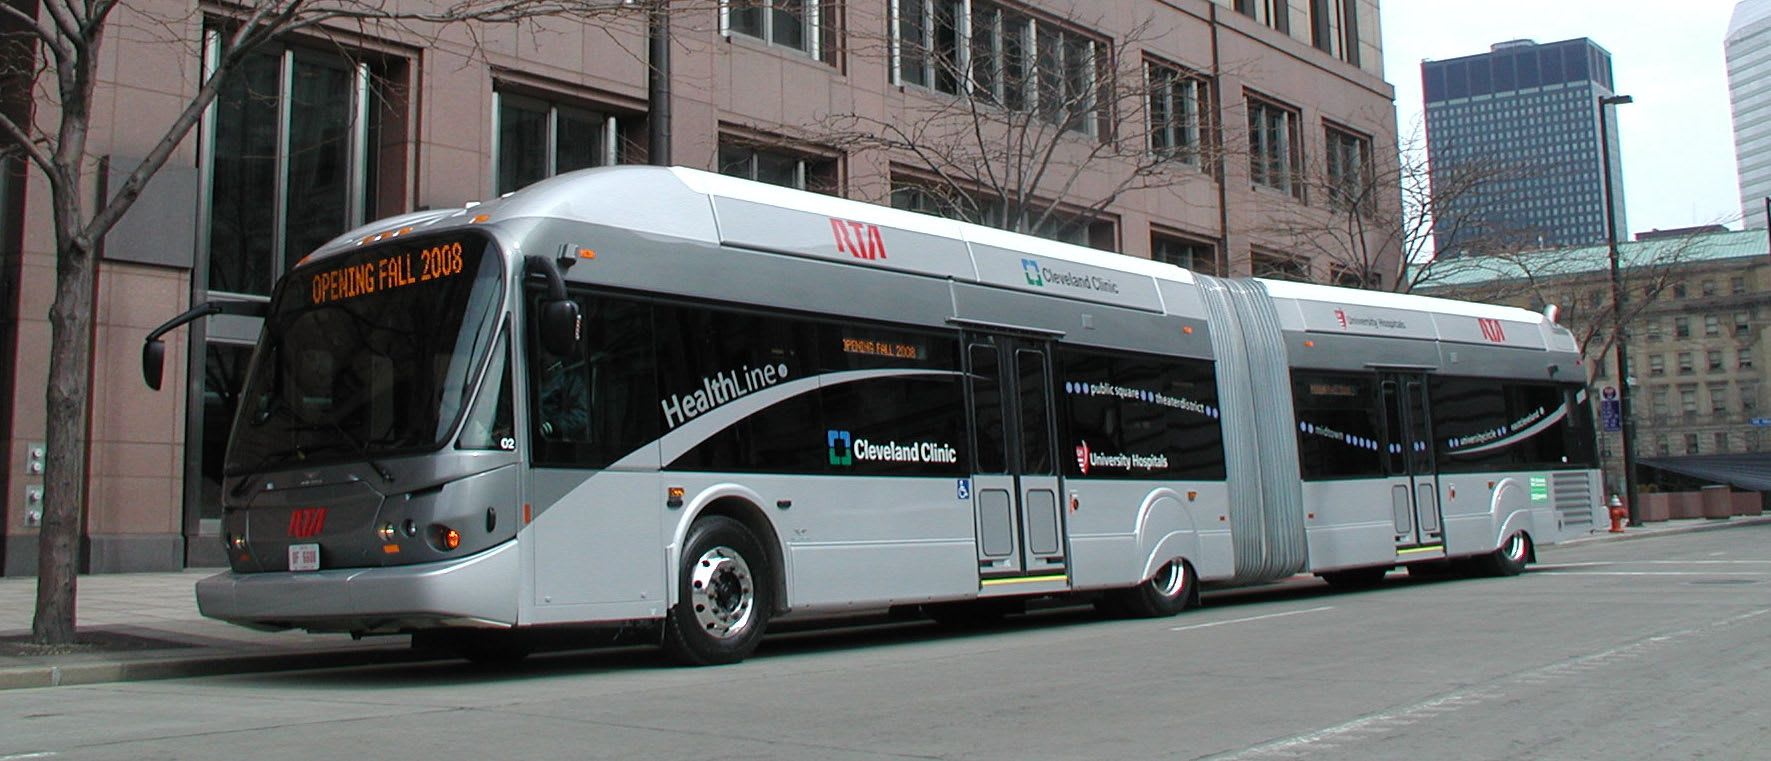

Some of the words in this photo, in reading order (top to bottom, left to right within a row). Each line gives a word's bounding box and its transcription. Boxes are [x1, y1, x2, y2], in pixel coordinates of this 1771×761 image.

[829, 218, 888, 261] RTA
[312, 262, 375, 304] OPENING
[378, 253, 416, 290] FALL
[420, 241, 464, 281] 2008
[1042, 267, 1091, 290] Cleveland
[1091, 275, 1119, 295] Clinic
[1478, 317, 1506, 343] RTA
[1090, 382, 1114, 396] public
[1115, 386, 1140, 399] square
[500, 437, 515, 449] 02
[853, 438, 920, 462] Cleveland
[920, 442, 957, 463] Clinic
[1089, 452, 1132, 470] University
[1131, 453, 1169, 470] Hospitals
